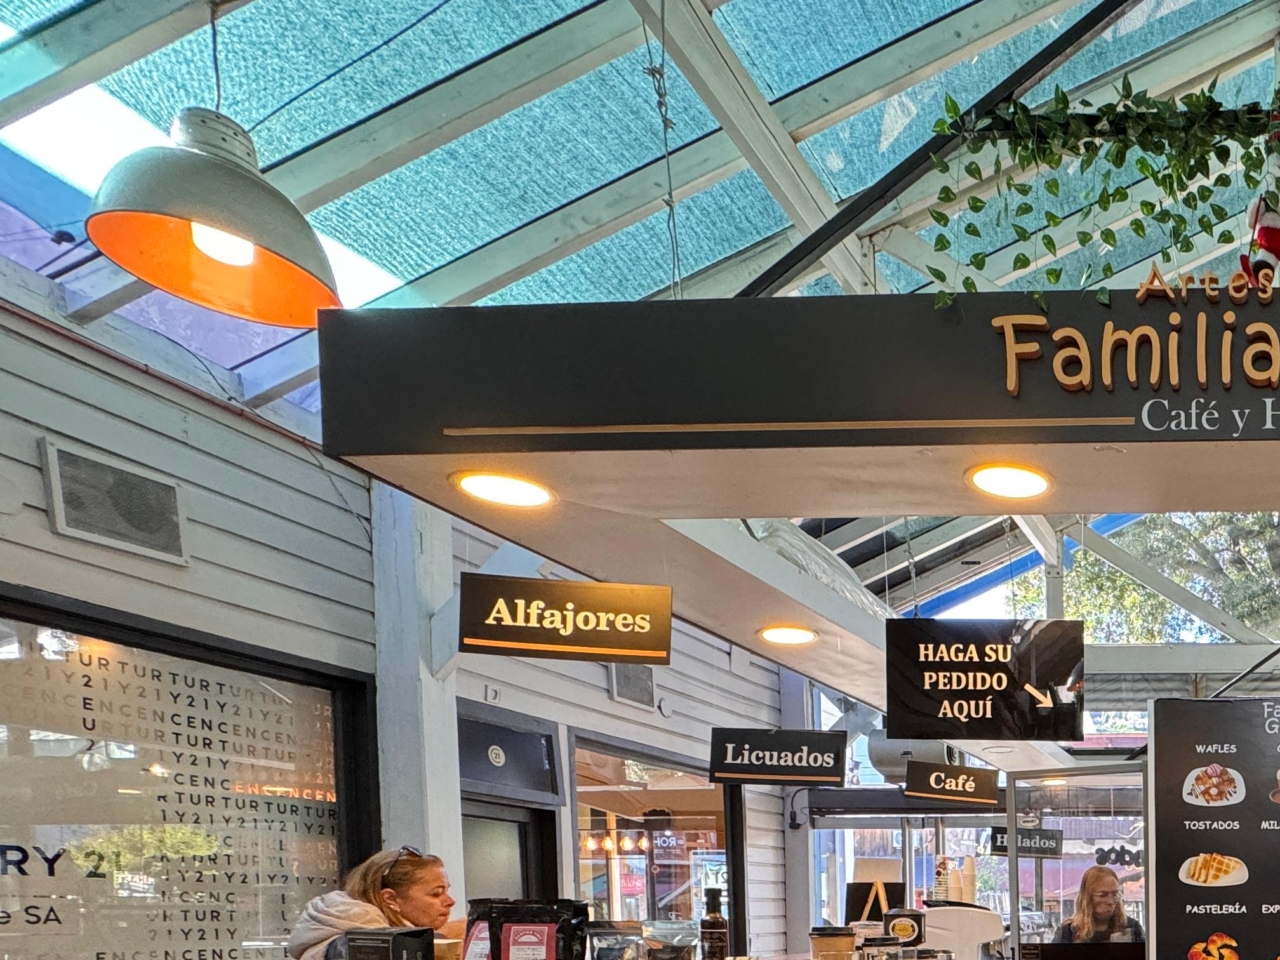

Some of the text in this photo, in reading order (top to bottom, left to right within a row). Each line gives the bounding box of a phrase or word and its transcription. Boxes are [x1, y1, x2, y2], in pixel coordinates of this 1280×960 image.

[1141, 398, 1220, 432] Café
[1231, 410, 1249, 436] y
[485, 598, 651, 635] Alfajores
[918, 643, 1012, 663] HAGA SU
[923, 671, 1008, 691] PEDIDO
[937, 697, 993, 721] AQUÍ
[724, 743, 834, 768] Licuados
[1195, 744, 1237, 753] WAFLES
[929, 771, 976, 793] Café
[1184, 821, 1240, 830] TOSTADOS
[996, 834, 1057, 848] Hlados
[24, 906, 62, 925] SA
[1186, 902, 1247, 914] PASTELERÍA
